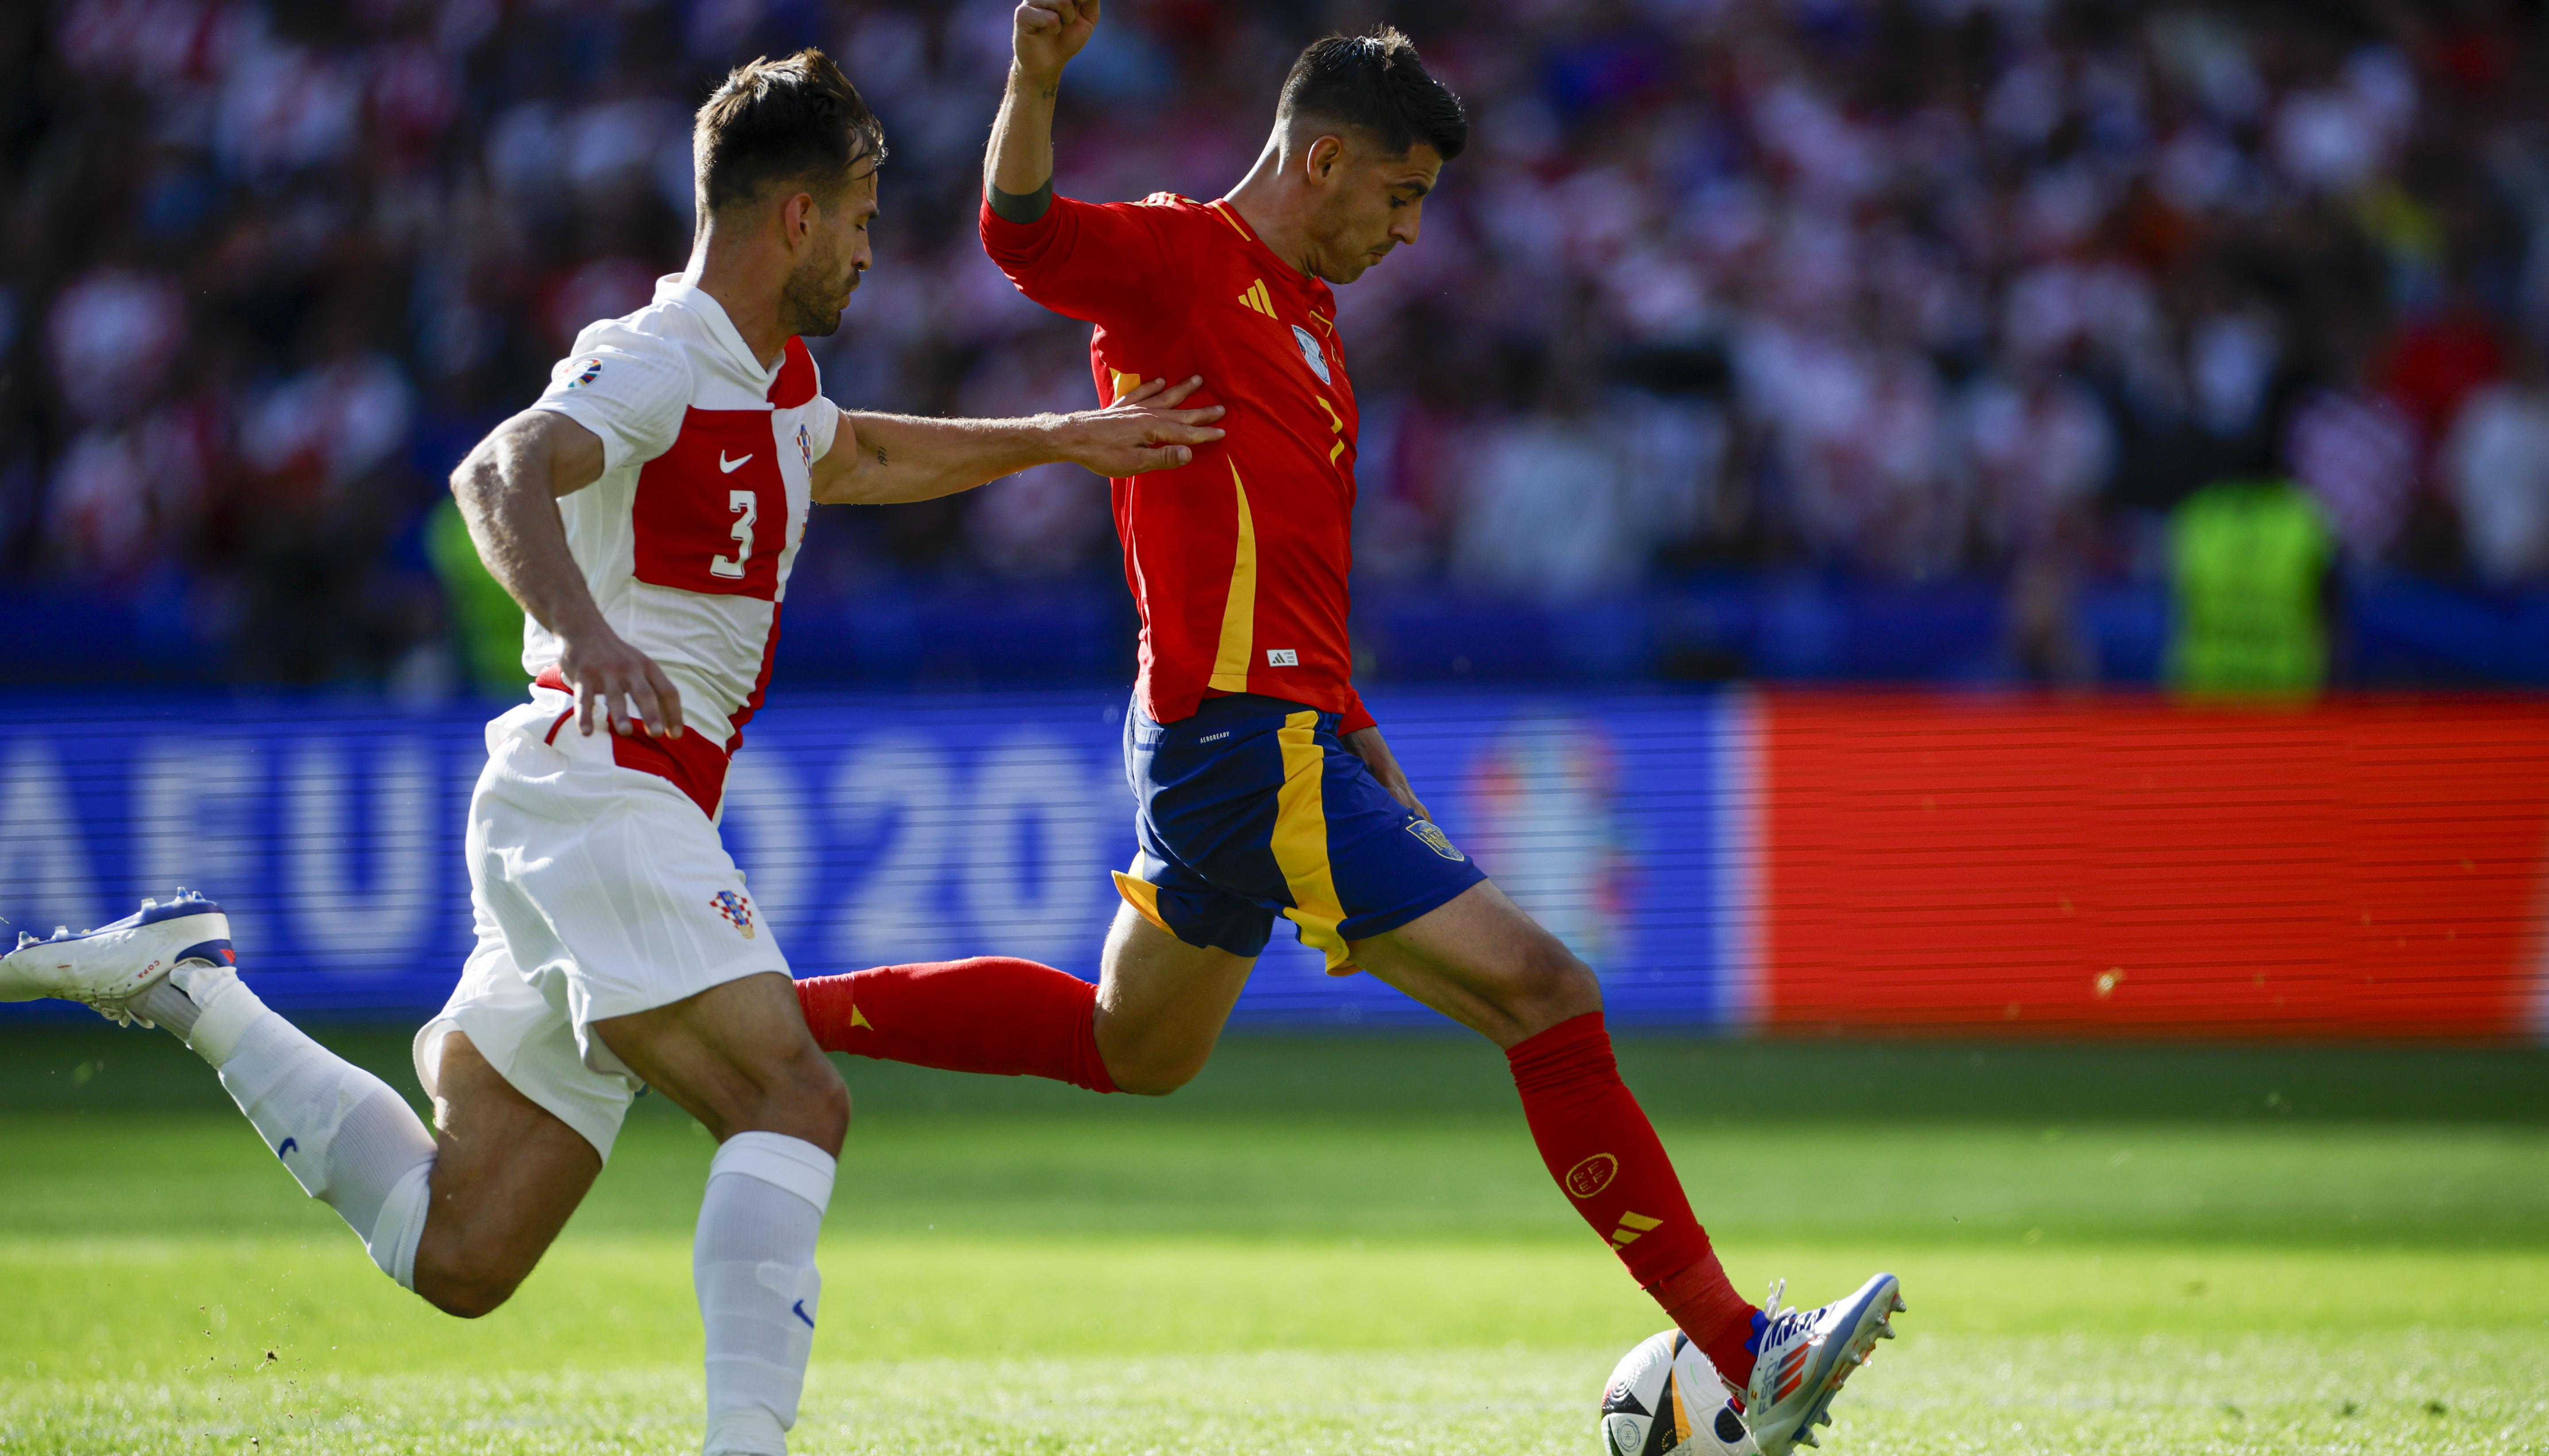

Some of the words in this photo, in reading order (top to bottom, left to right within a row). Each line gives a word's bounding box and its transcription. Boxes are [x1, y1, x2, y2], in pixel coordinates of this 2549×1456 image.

[710, 490, 757, 579] 3
[1200, 731, 1229, 743] AEROREADY
[138, 960, 160, 978] COPA
